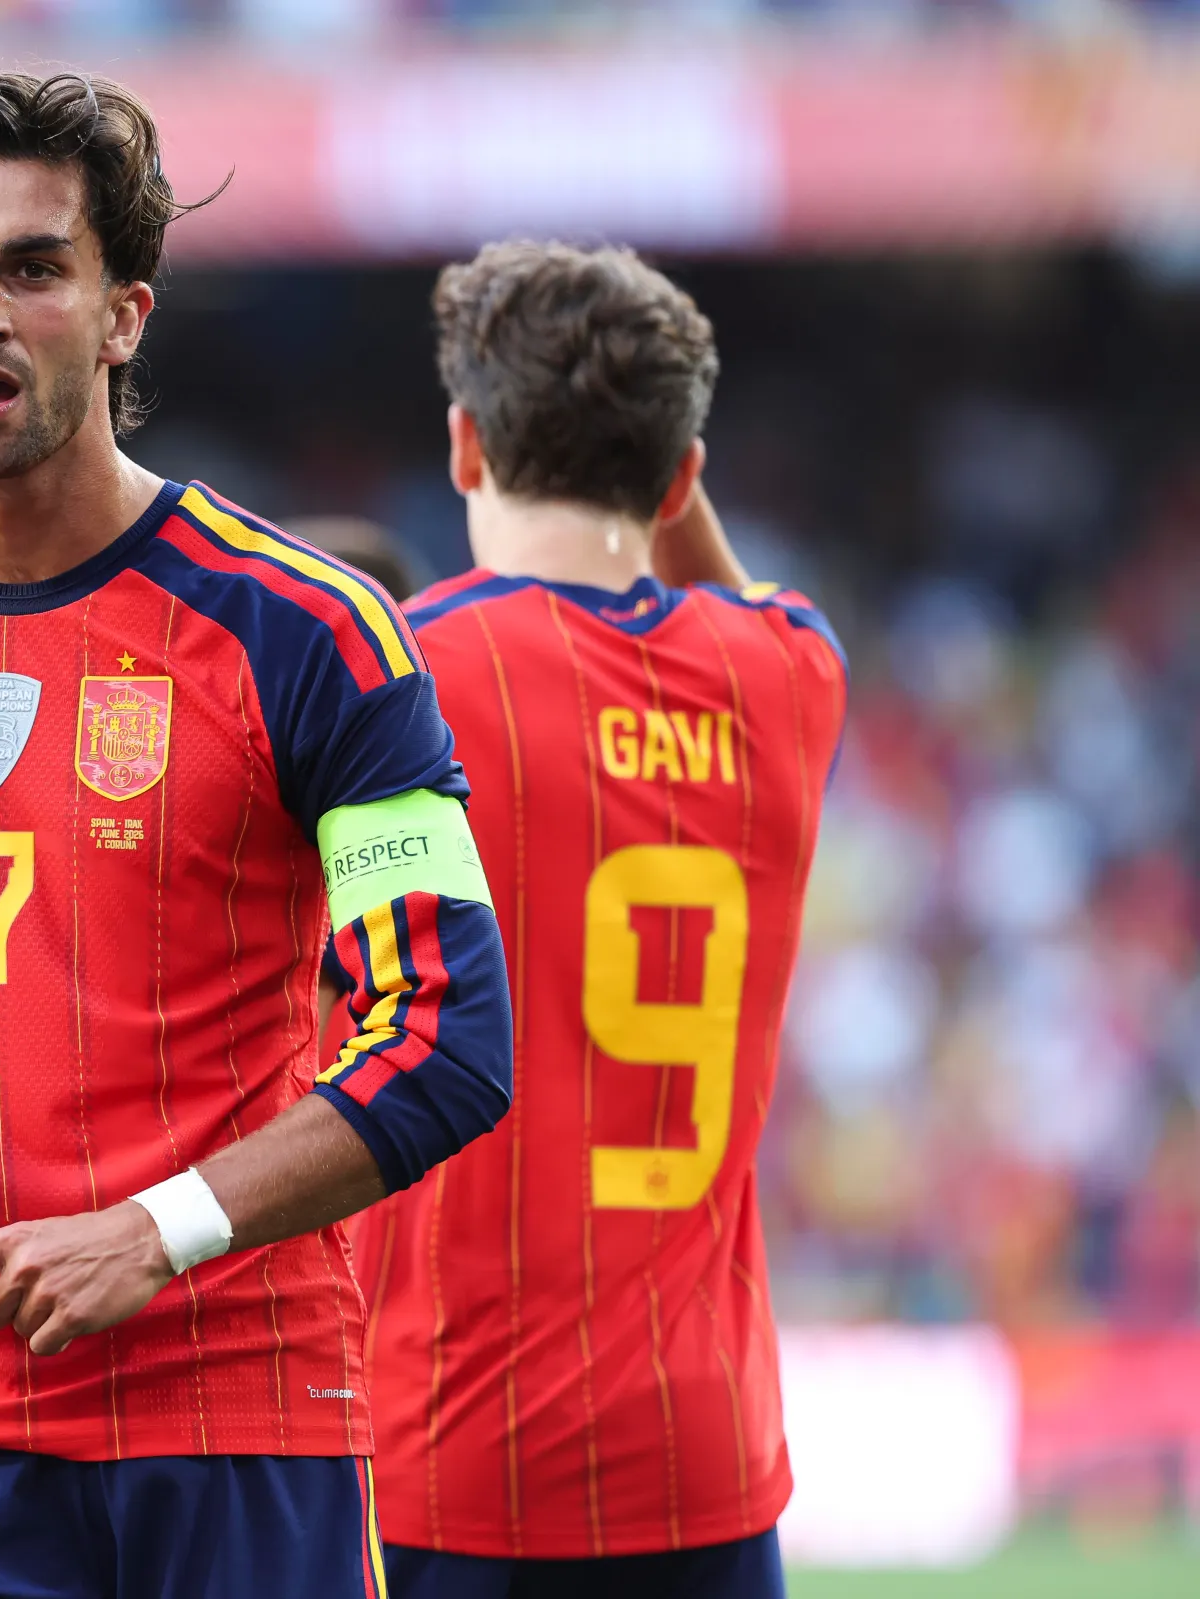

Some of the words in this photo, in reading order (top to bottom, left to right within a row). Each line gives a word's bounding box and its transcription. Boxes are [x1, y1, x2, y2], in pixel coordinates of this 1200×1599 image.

[599, 706, 737, 784] GAVI
[89, 828, 96, 838] 4
[99, 829, 120, 839] JUNE
[91, 818, 115, 828] SPAIN
[124, 819, 143, 829] IRAK
[96, 839, 102, 849] A
[105, 838, 137, 850] CORUÑA
[334, 836, 429, 880] RESPECT
[581, 844, 749, 1211] 9
